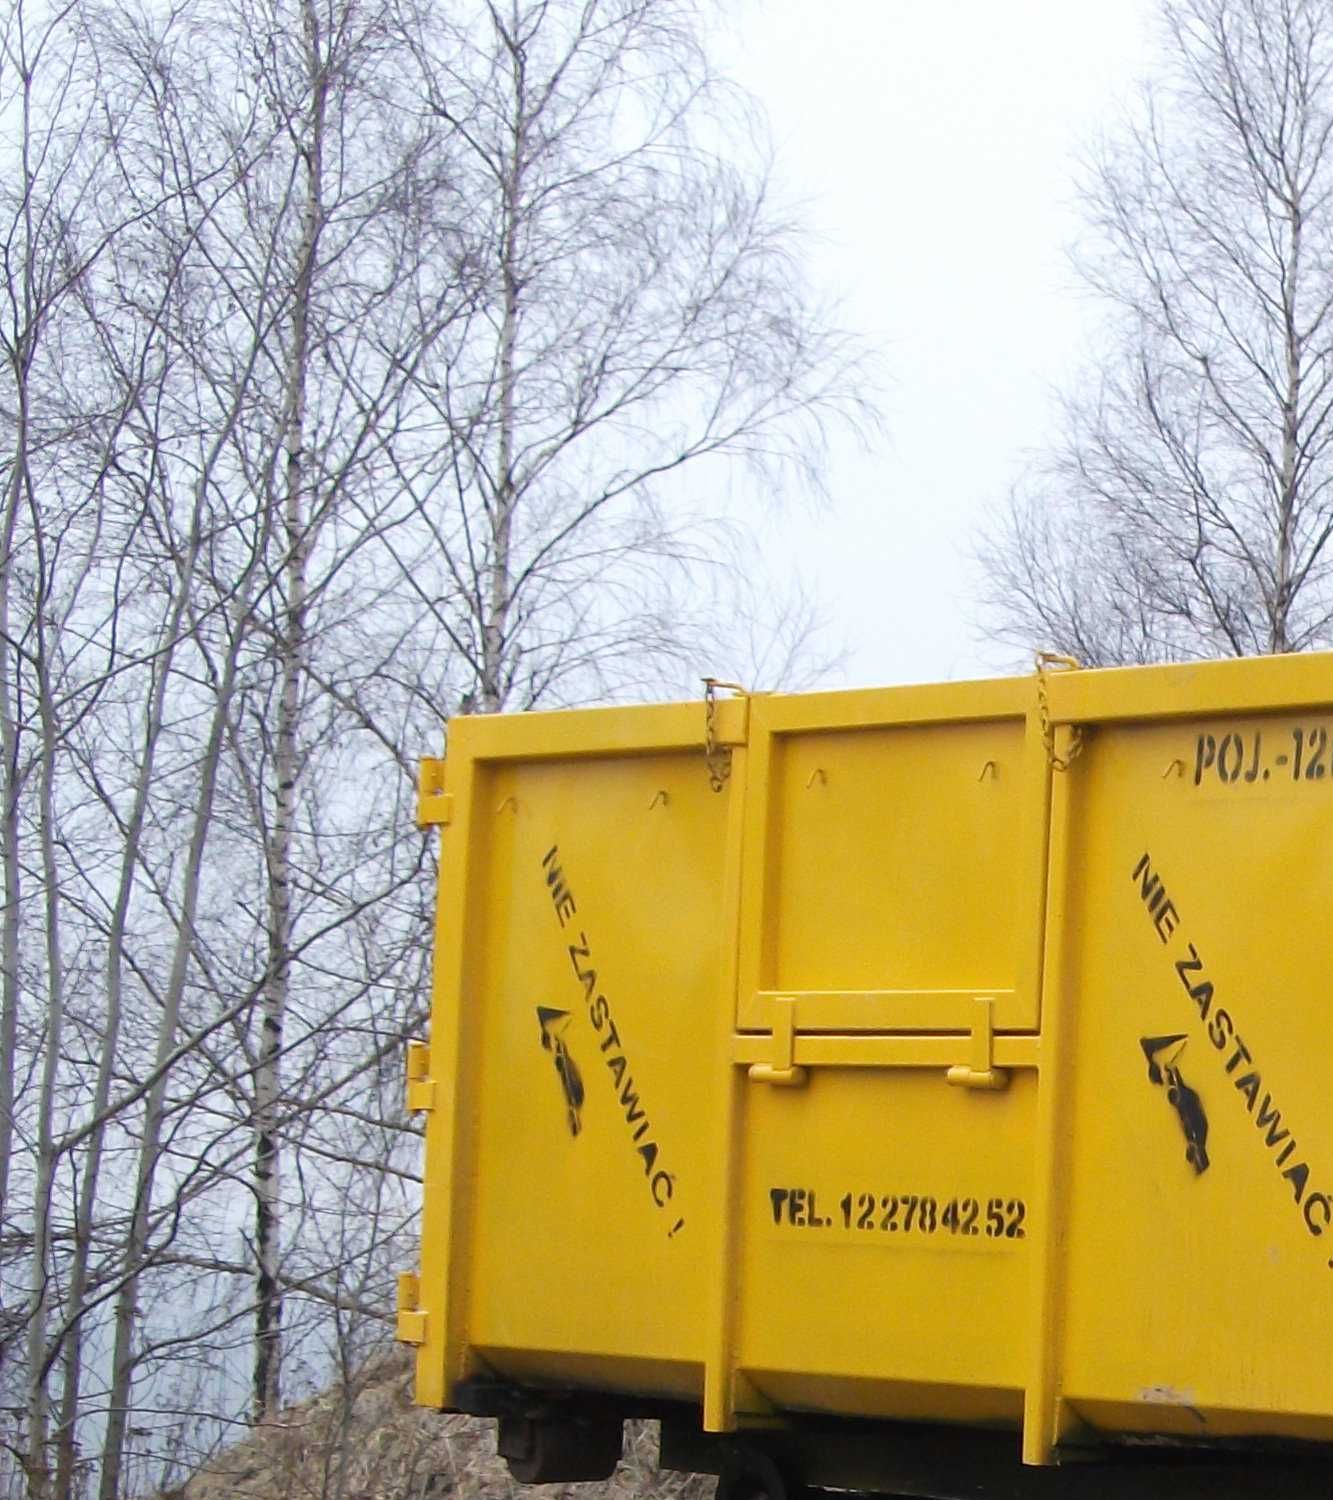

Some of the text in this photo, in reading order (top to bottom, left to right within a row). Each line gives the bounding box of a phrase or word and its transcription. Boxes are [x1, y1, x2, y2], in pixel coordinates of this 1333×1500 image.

[1132, 852, 1180, 945] NIE
[542, 845, 577, 928] NIE
[568, 931, 675, 1208] ZASTAWIAĆ
